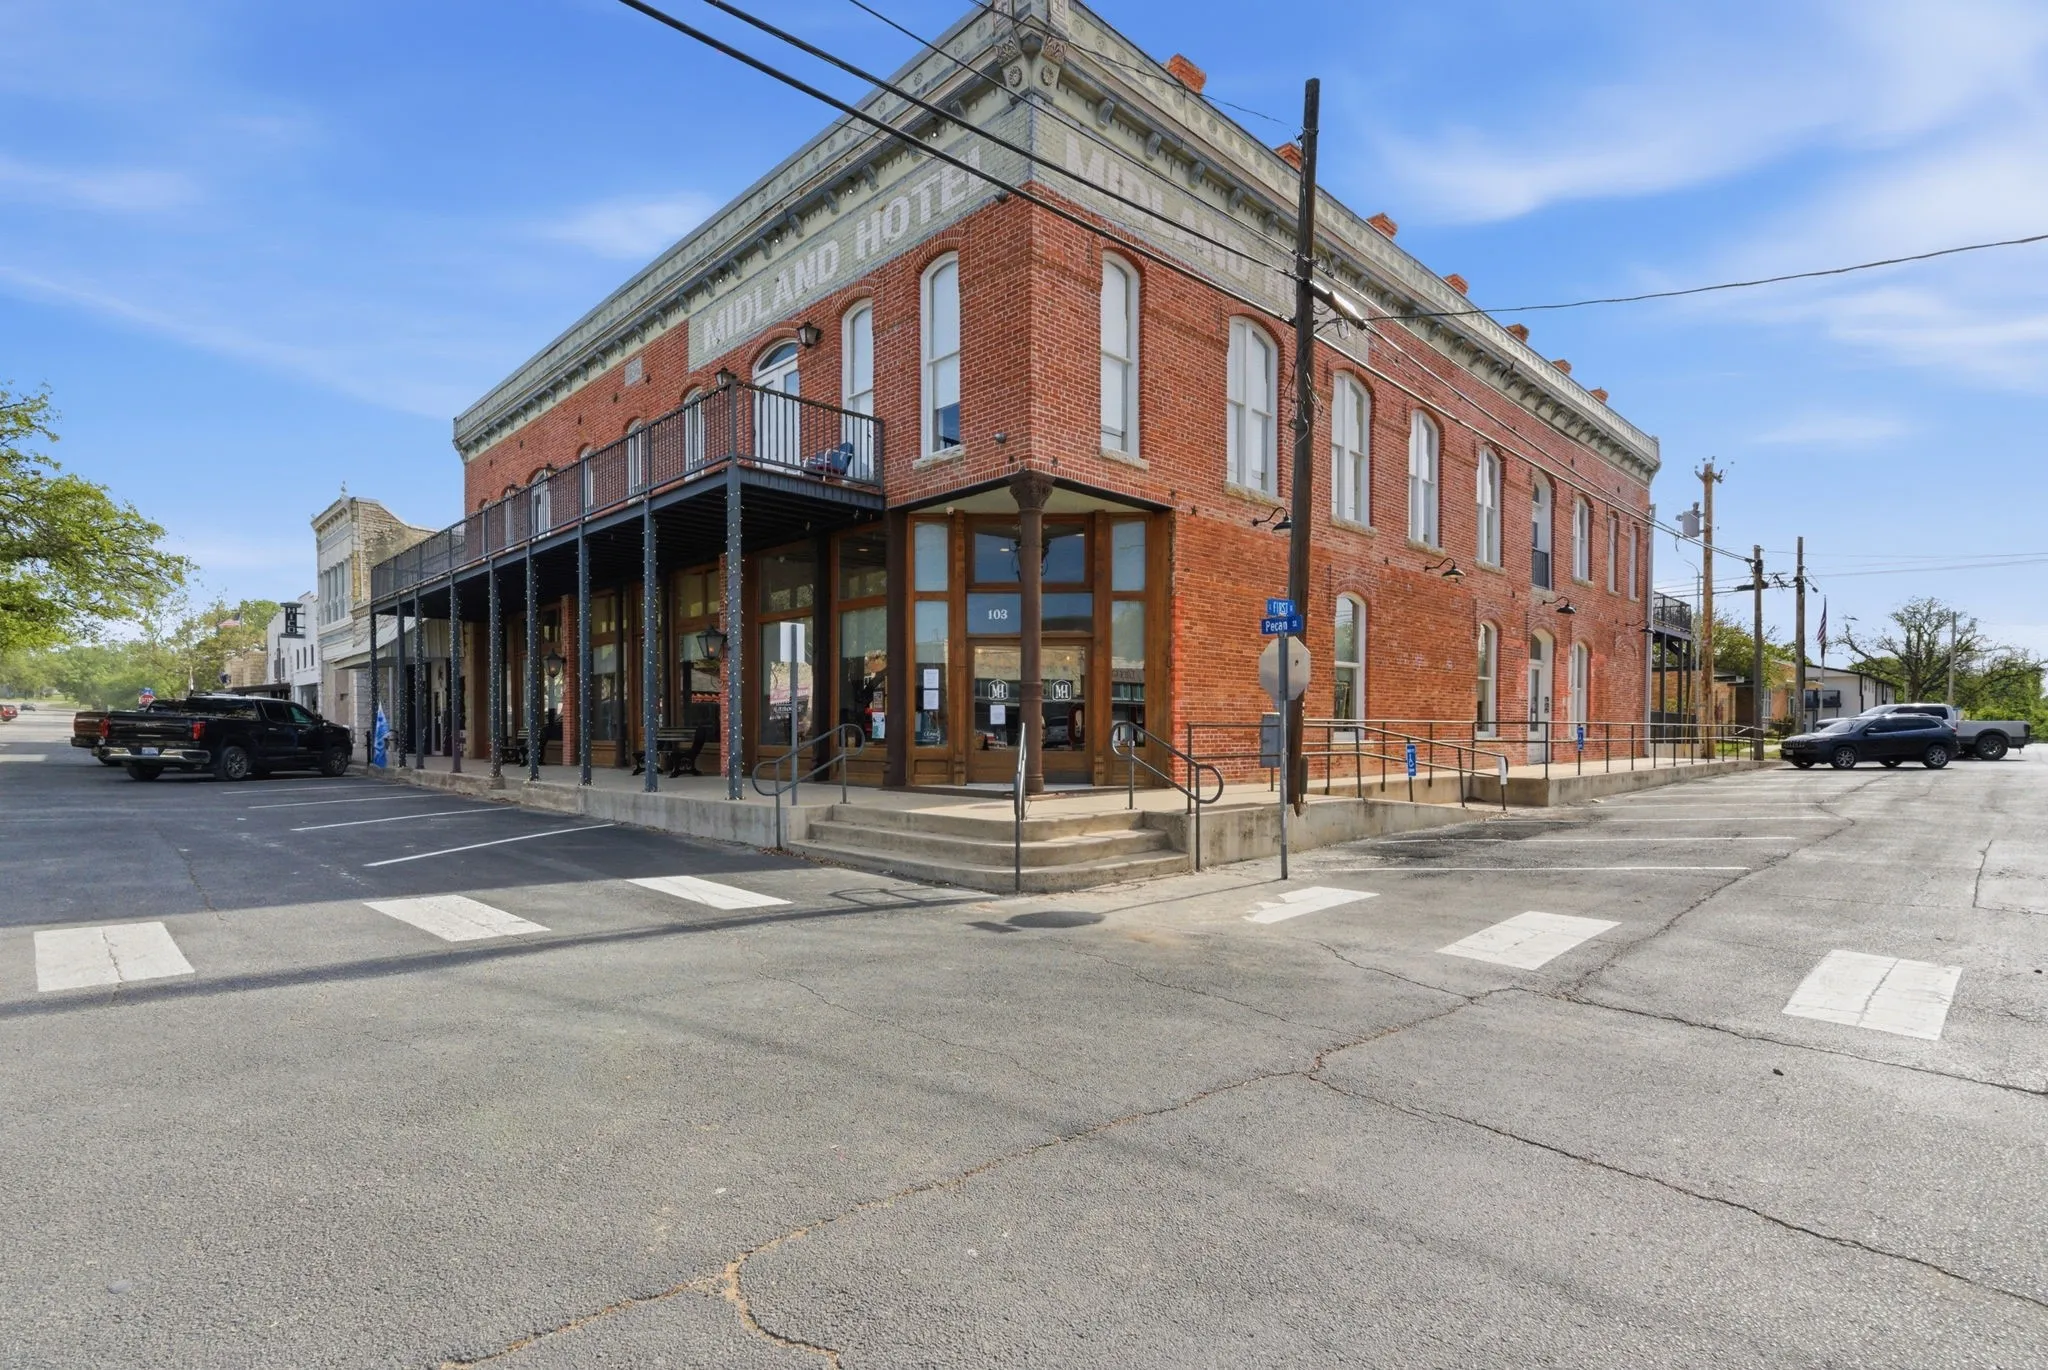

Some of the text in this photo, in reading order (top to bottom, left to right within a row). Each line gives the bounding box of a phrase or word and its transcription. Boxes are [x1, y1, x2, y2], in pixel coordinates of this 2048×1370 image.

[703, 145, 989, 352] MIDLAND HOTEL
[1273, 601, 1288, 614] FIRST
[988, 609, 1008, 620] 103
[1265, 620, 1288, 632] Pecan
[991, 683, 1005, 698] MH
[1055, 684, 1069, 698] MH
